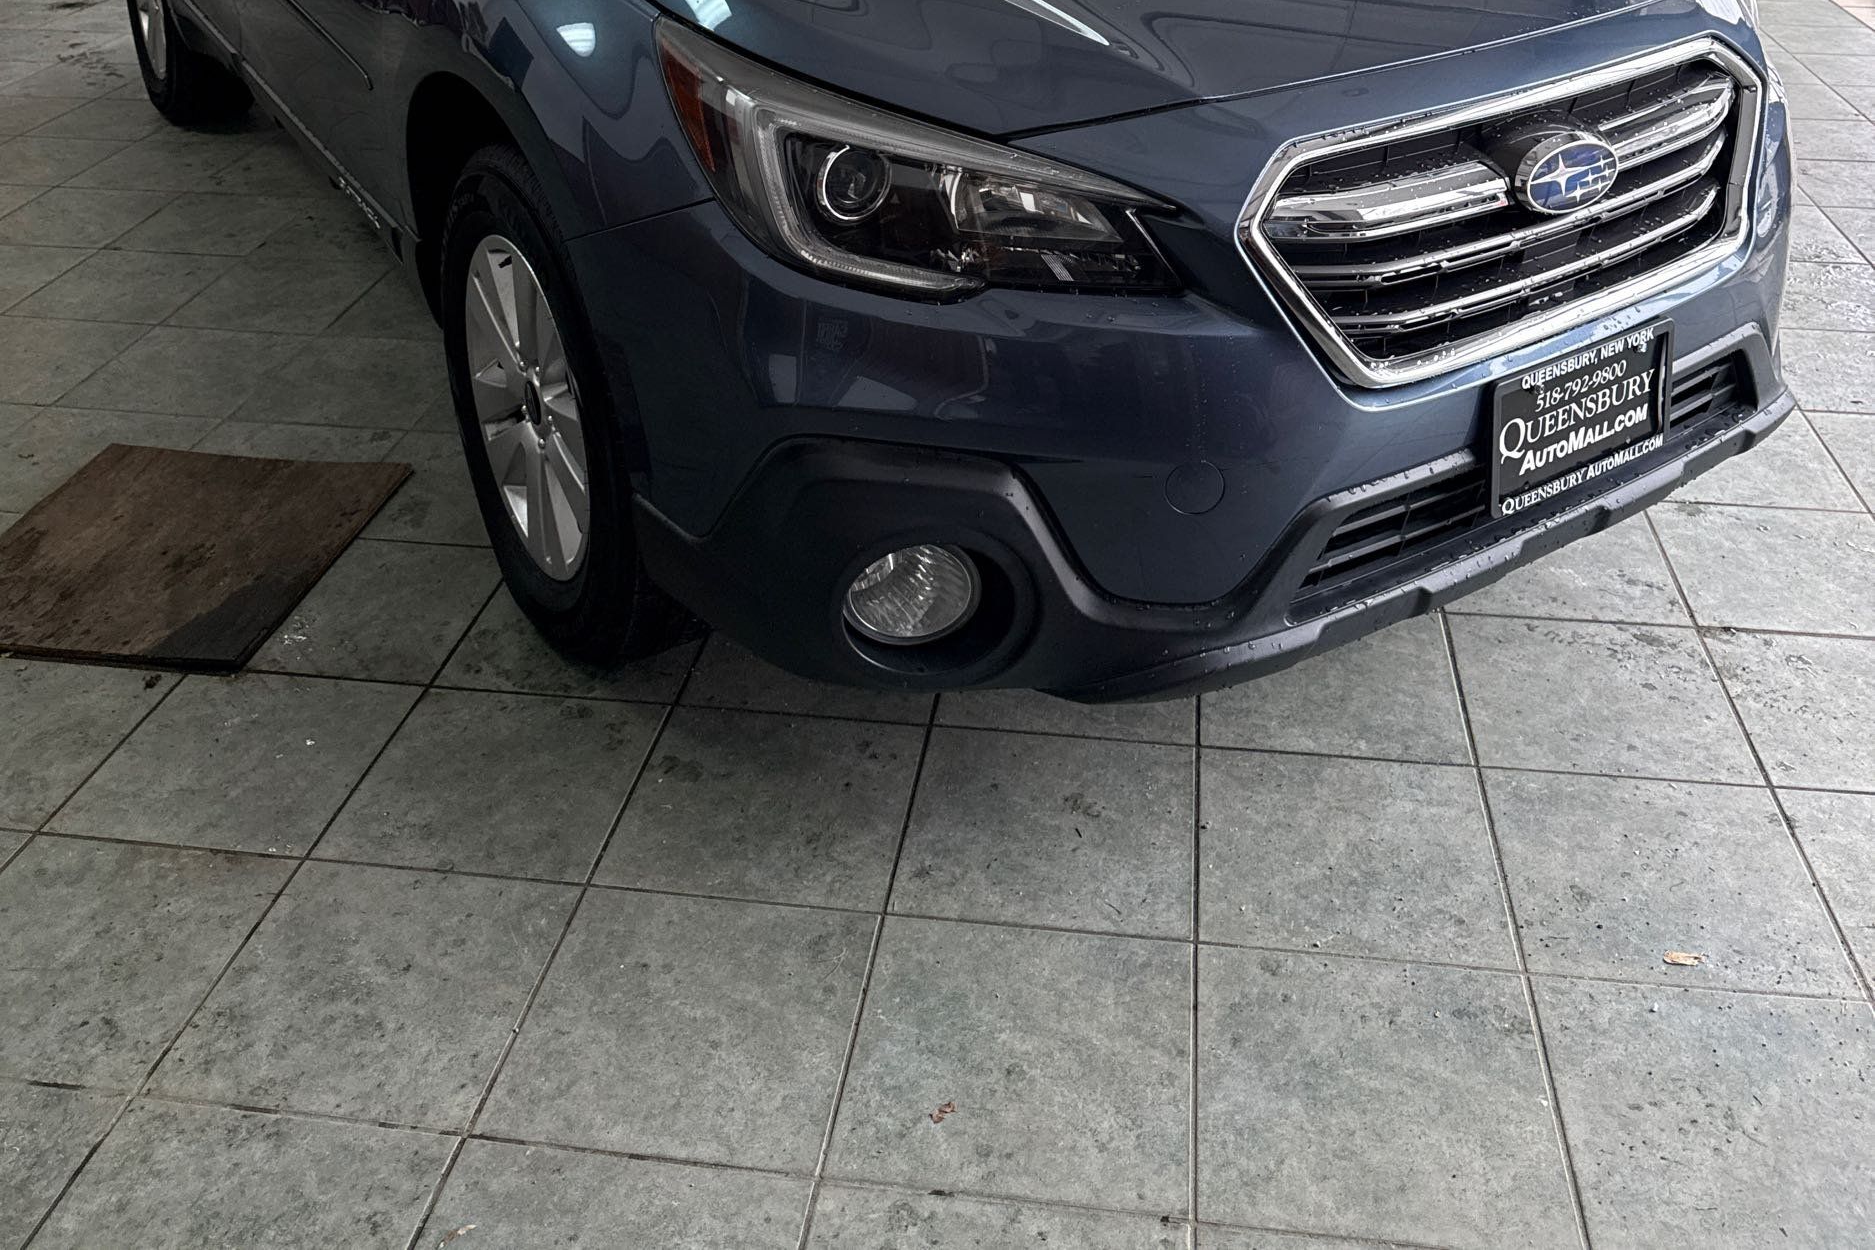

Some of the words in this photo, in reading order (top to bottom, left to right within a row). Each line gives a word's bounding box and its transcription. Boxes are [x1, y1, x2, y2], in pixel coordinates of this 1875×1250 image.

[1521, 350, 1598, 389] QUEENSBURY,
[1600, 339, 1625, 359] NEW
[1626, 328, 1654, 347] YORK
[1535, 359, 1627, 412] 518-792-9800
[1499, 368, 1655, 464] QUEENSBURY
[1501, 467, 1588, 516] QUEENSBURY
